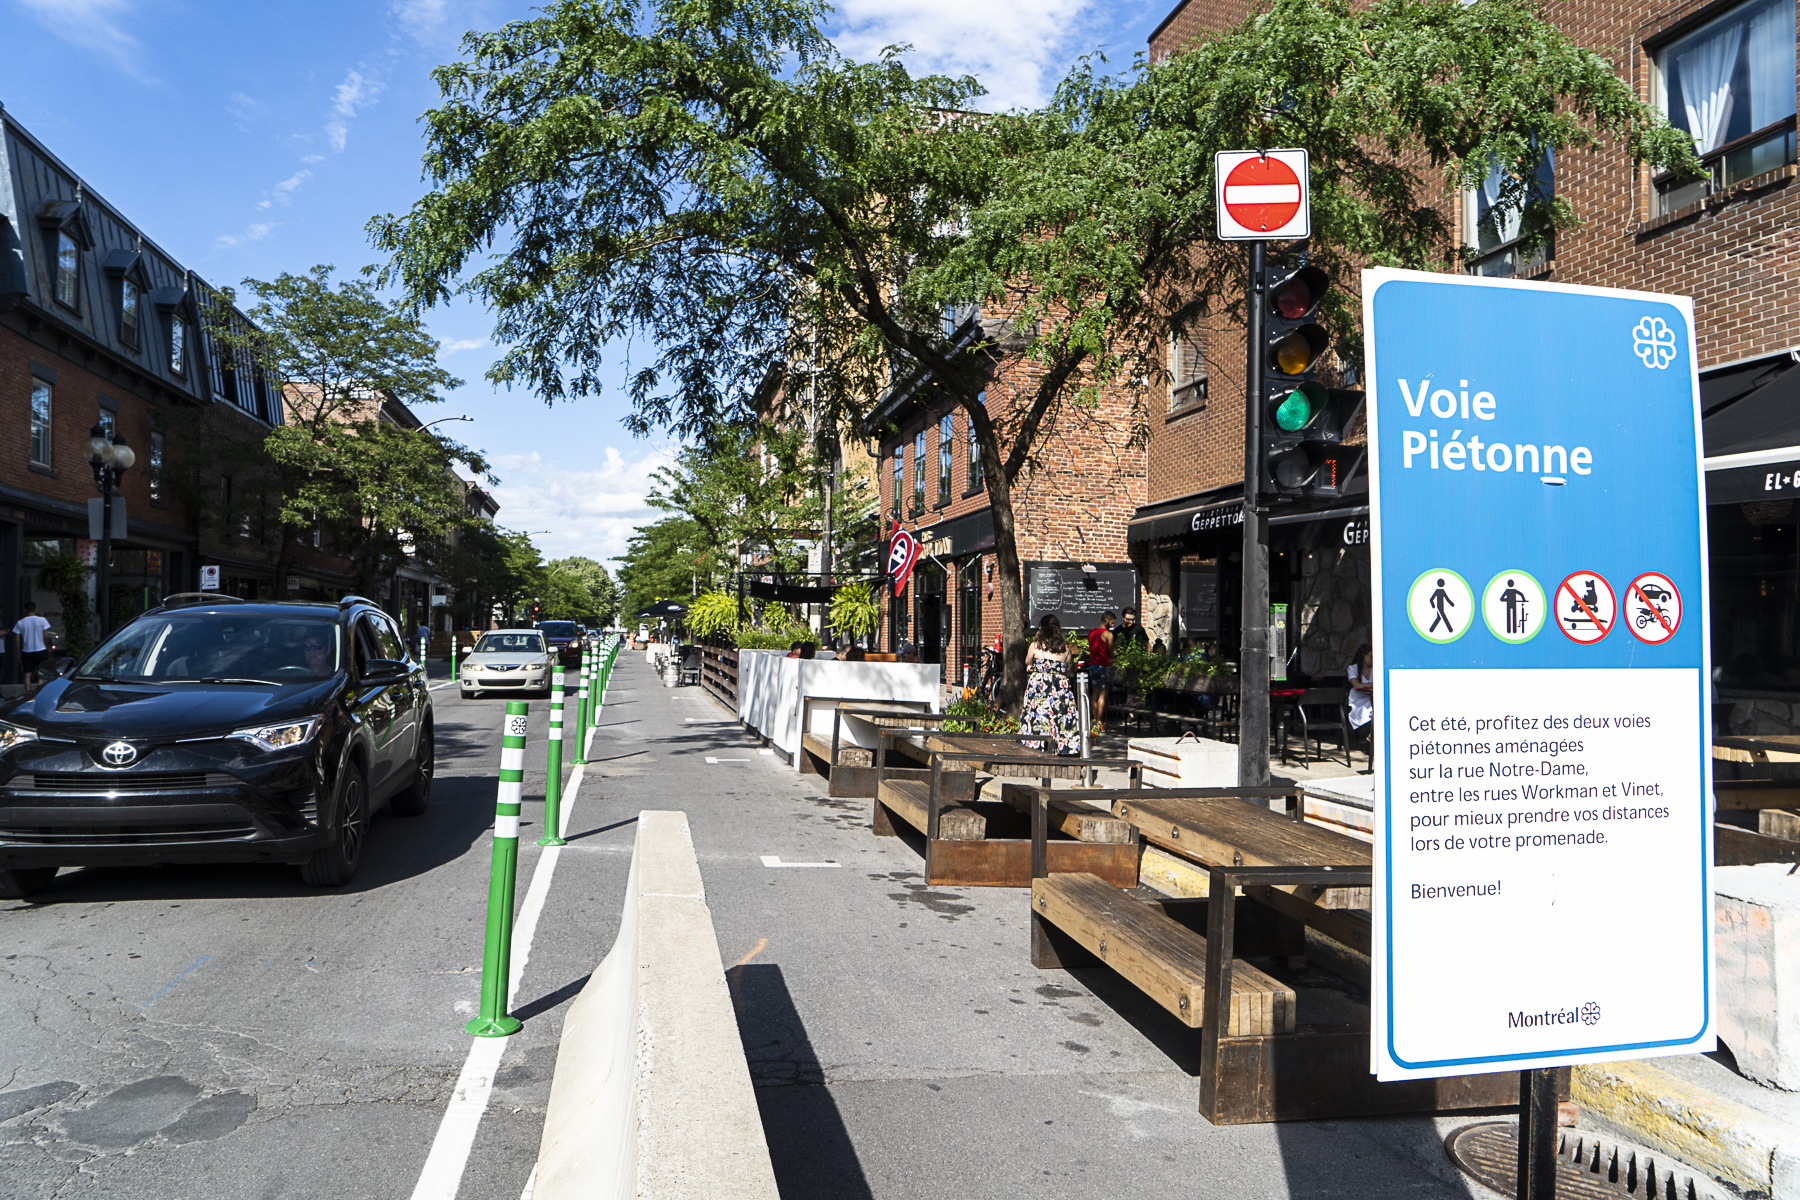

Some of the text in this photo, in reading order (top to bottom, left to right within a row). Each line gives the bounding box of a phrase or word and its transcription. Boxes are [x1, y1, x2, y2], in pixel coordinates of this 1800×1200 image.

[1397, 377, 1497, 421] Voie
[1402, 429, 1593, 476] Piétonne
[1409, 713, 1651, 735] Cet été, profitez des deux voies
[1409, 738, 1584, 760] piétonnes aménagées
[1409, 760, 1589, 780] sur la rue Notre-Dame,
[1409, 781, 1664, 804] entre les rues Workman et Vinet,
[1410, 805, 1670, 832] pour mieux prendre vos distances
[1411, 829, 1609, 852] lors de votre promenade.
[1411, 879, 1502, 900] Bienvenue!
[1508, 1006, 1579, 1029] Montréal
